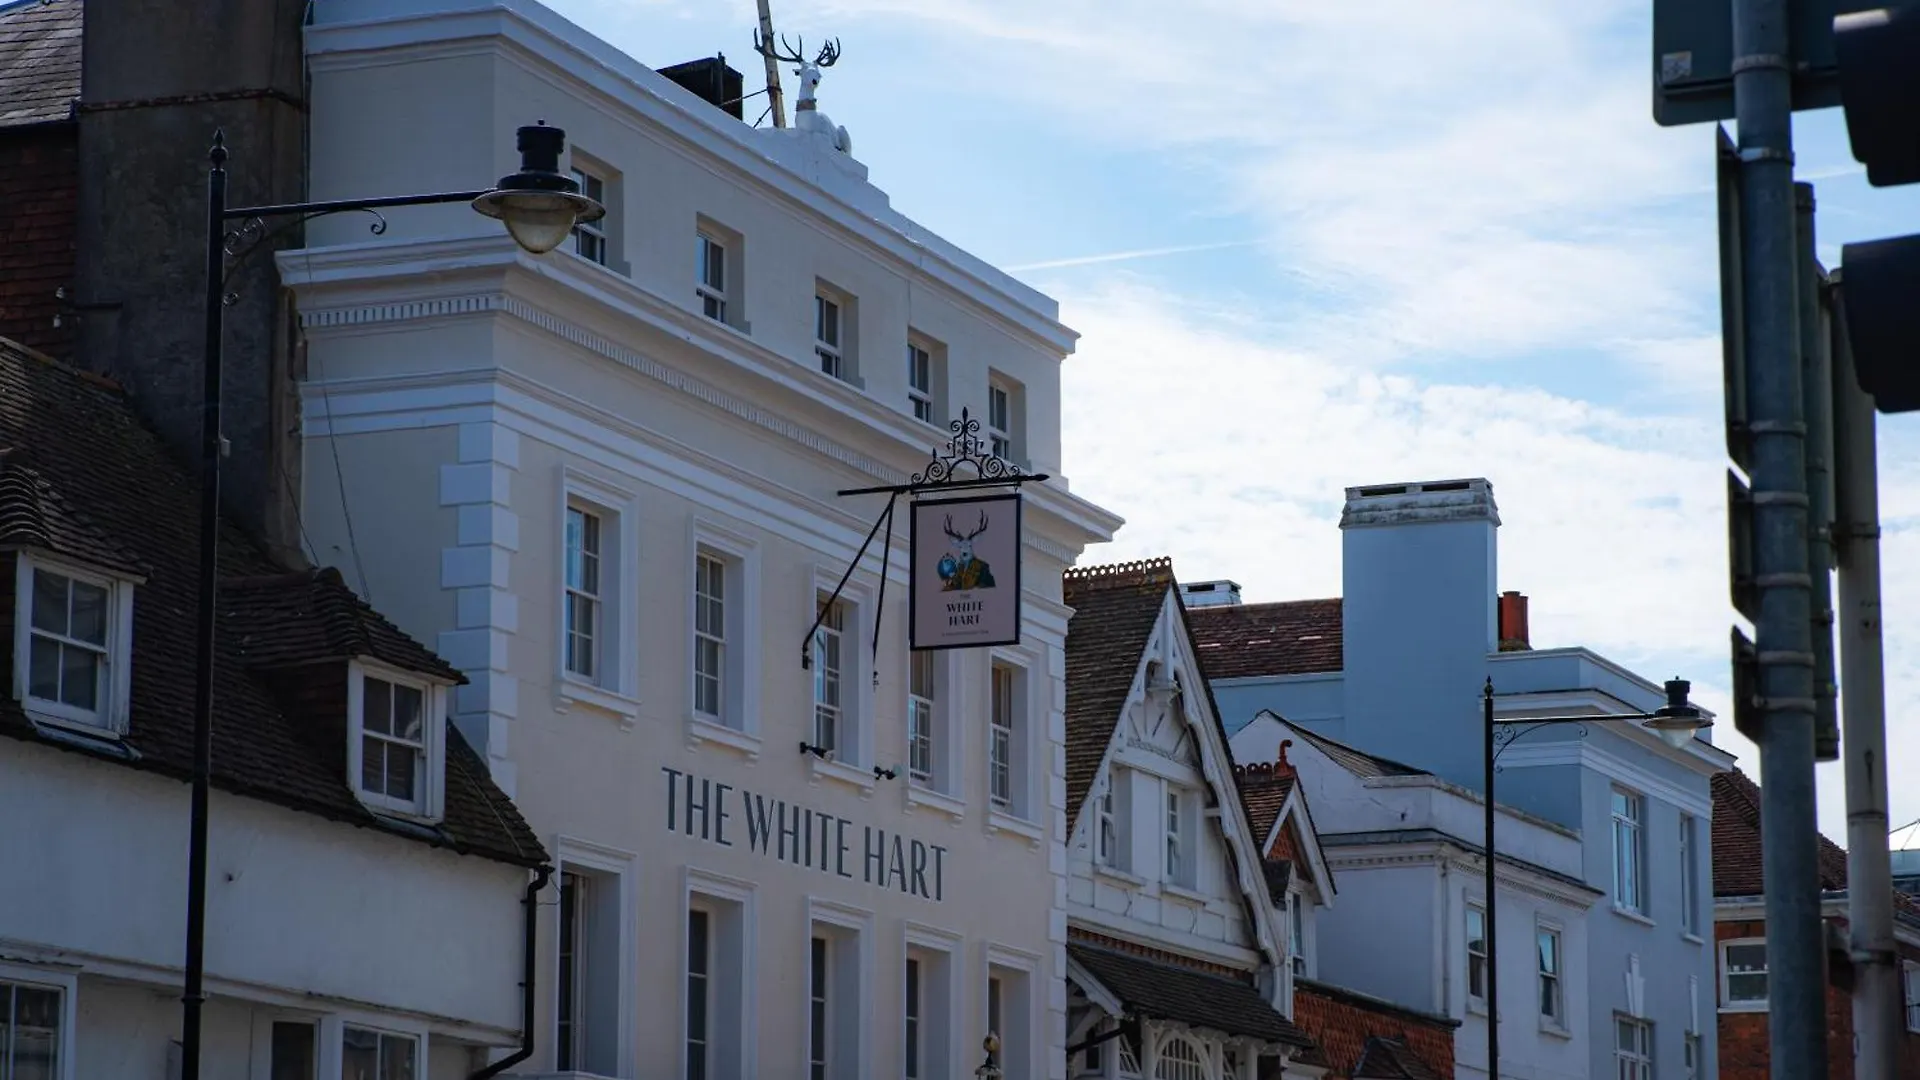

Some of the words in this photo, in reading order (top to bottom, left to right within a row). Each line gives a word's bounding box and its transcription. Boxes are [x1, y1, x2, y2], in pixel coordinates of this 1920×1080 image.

[946, 601, 984, 613] WHITE
[949, 614, 980, 627] HART
[661, 767, 733, 847] THE
[743, 790, 853, 878] WHITE
[864, 826, 948, 902] HART
